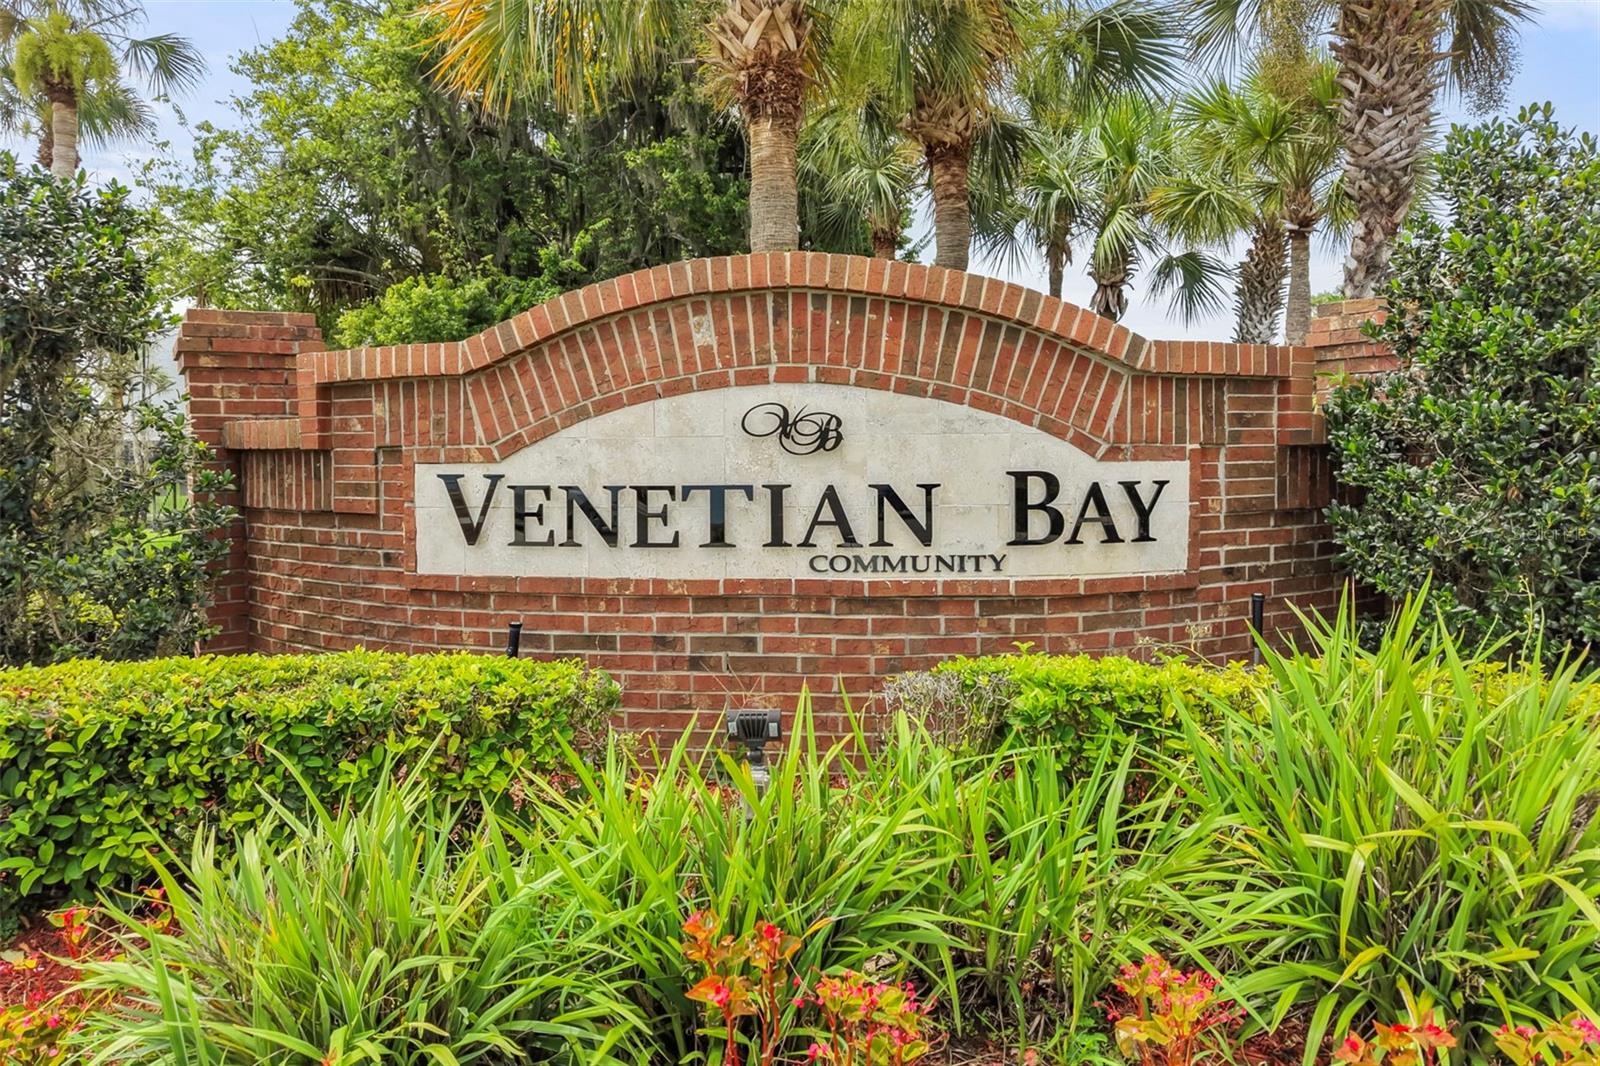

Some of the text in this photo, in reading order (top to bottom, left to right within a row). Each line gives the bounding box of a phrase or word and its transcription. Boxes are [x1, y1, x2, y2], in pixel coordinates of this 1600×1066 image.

[436, 470, 1170, 549] VENETIAN BAY
[808, 553, 1007, 573] COMMUNITY
